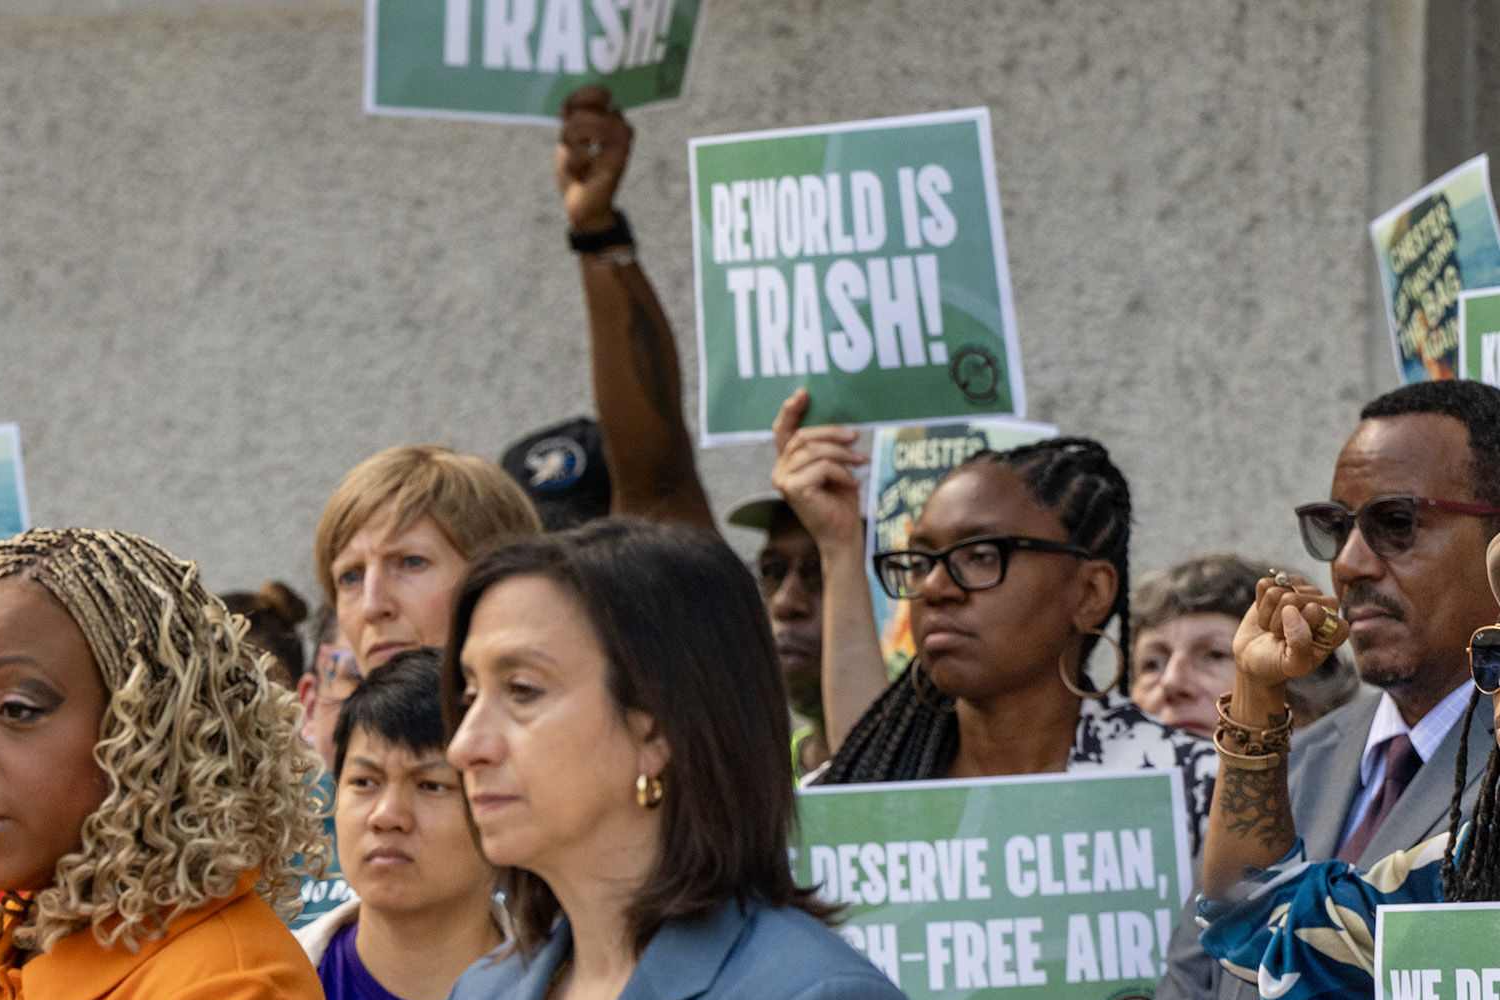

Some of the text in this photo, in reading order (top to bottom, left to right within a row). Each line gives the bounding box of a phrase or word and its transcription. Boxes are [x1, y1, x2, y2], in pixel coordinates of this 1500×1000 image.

[711, 163, 958, 264] REWORLD IS
[726, 253, 949, 378] TRASH!
[810, 837, 991, 906] DESERVE
[1004, 828, 1169, 899] CLEAN,
[1066, 909, 1171, 983] AIR!
